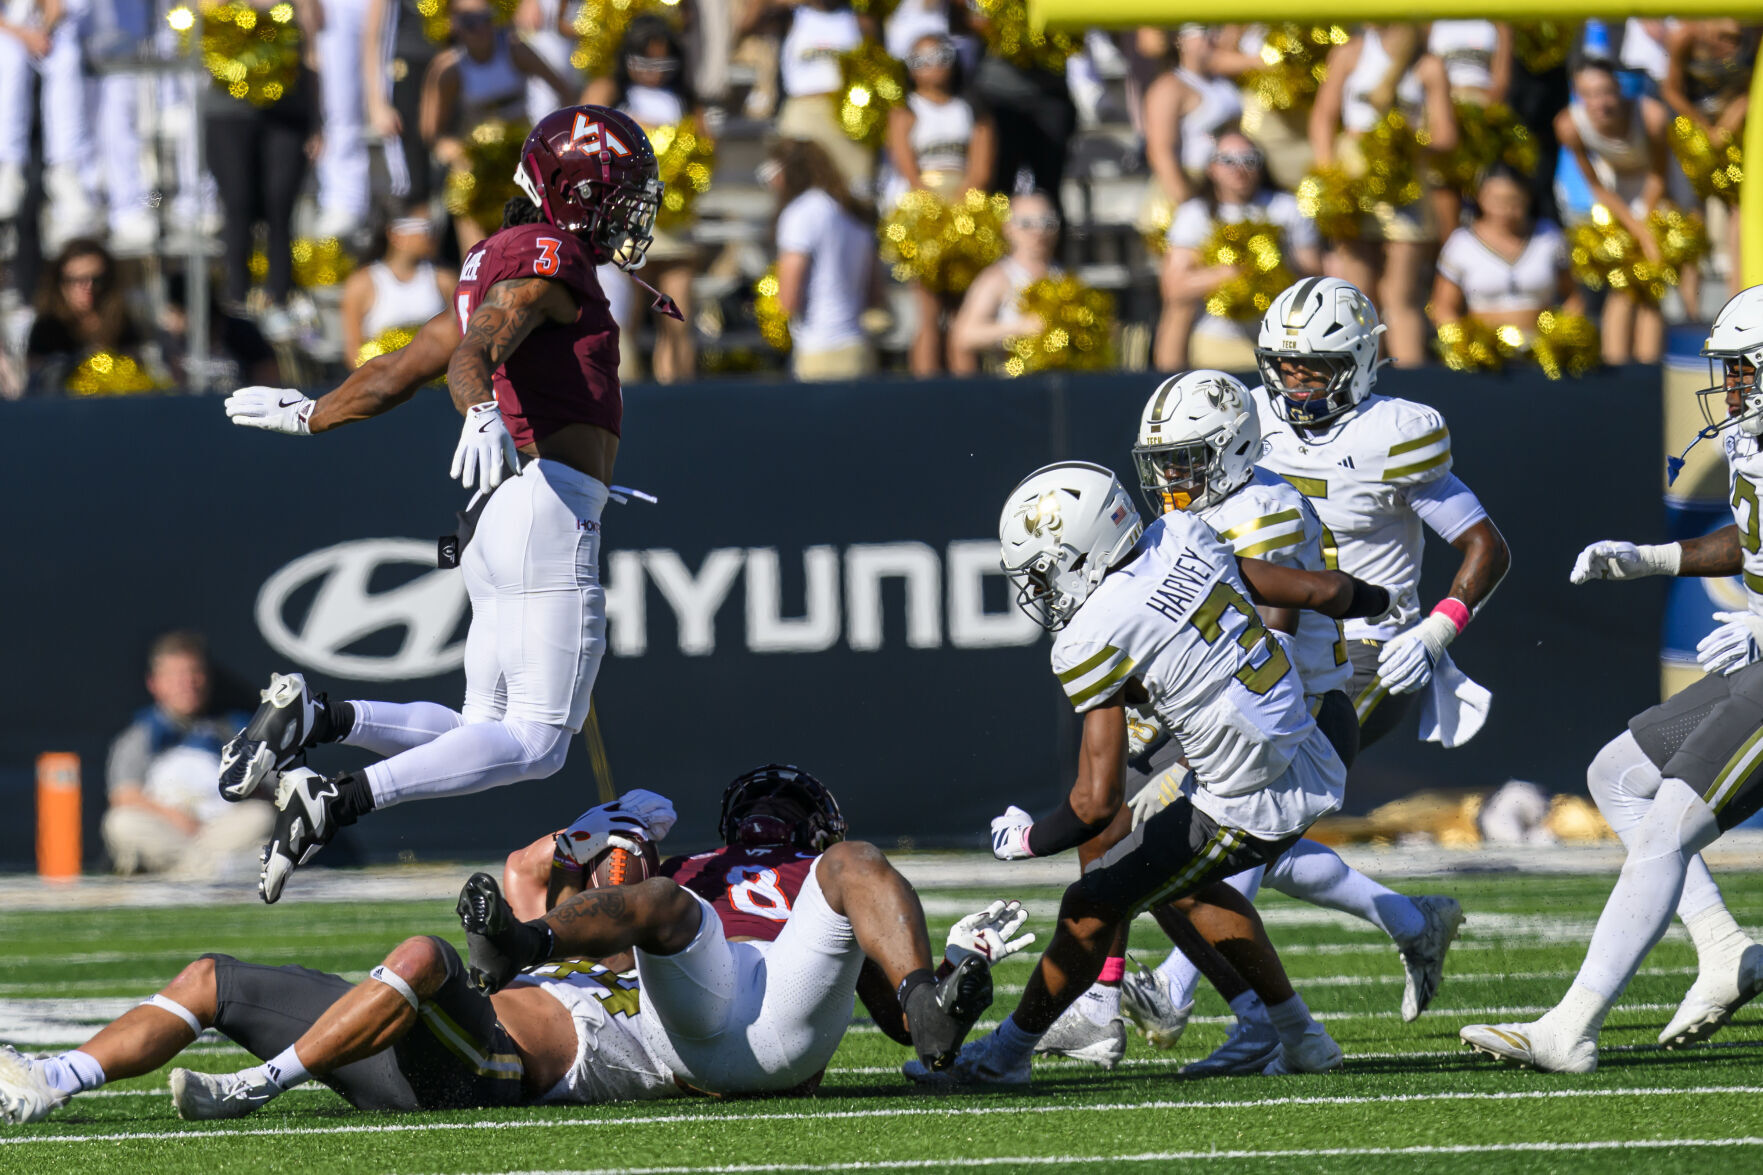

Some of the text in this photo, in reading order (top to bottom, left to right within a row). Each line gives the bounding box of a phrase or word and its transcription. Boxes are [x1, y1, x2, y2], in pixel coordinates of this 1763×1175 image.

[533, 237, 562, 277] 3
[1282, 340, 1297, 349] TECH
[1146, 436, 1162, 445] TECH
[1146, 546, 1215, 623] HARVEY
[1190, 581, 1292, 695] 3
[724, 864, 792, 922] 8
